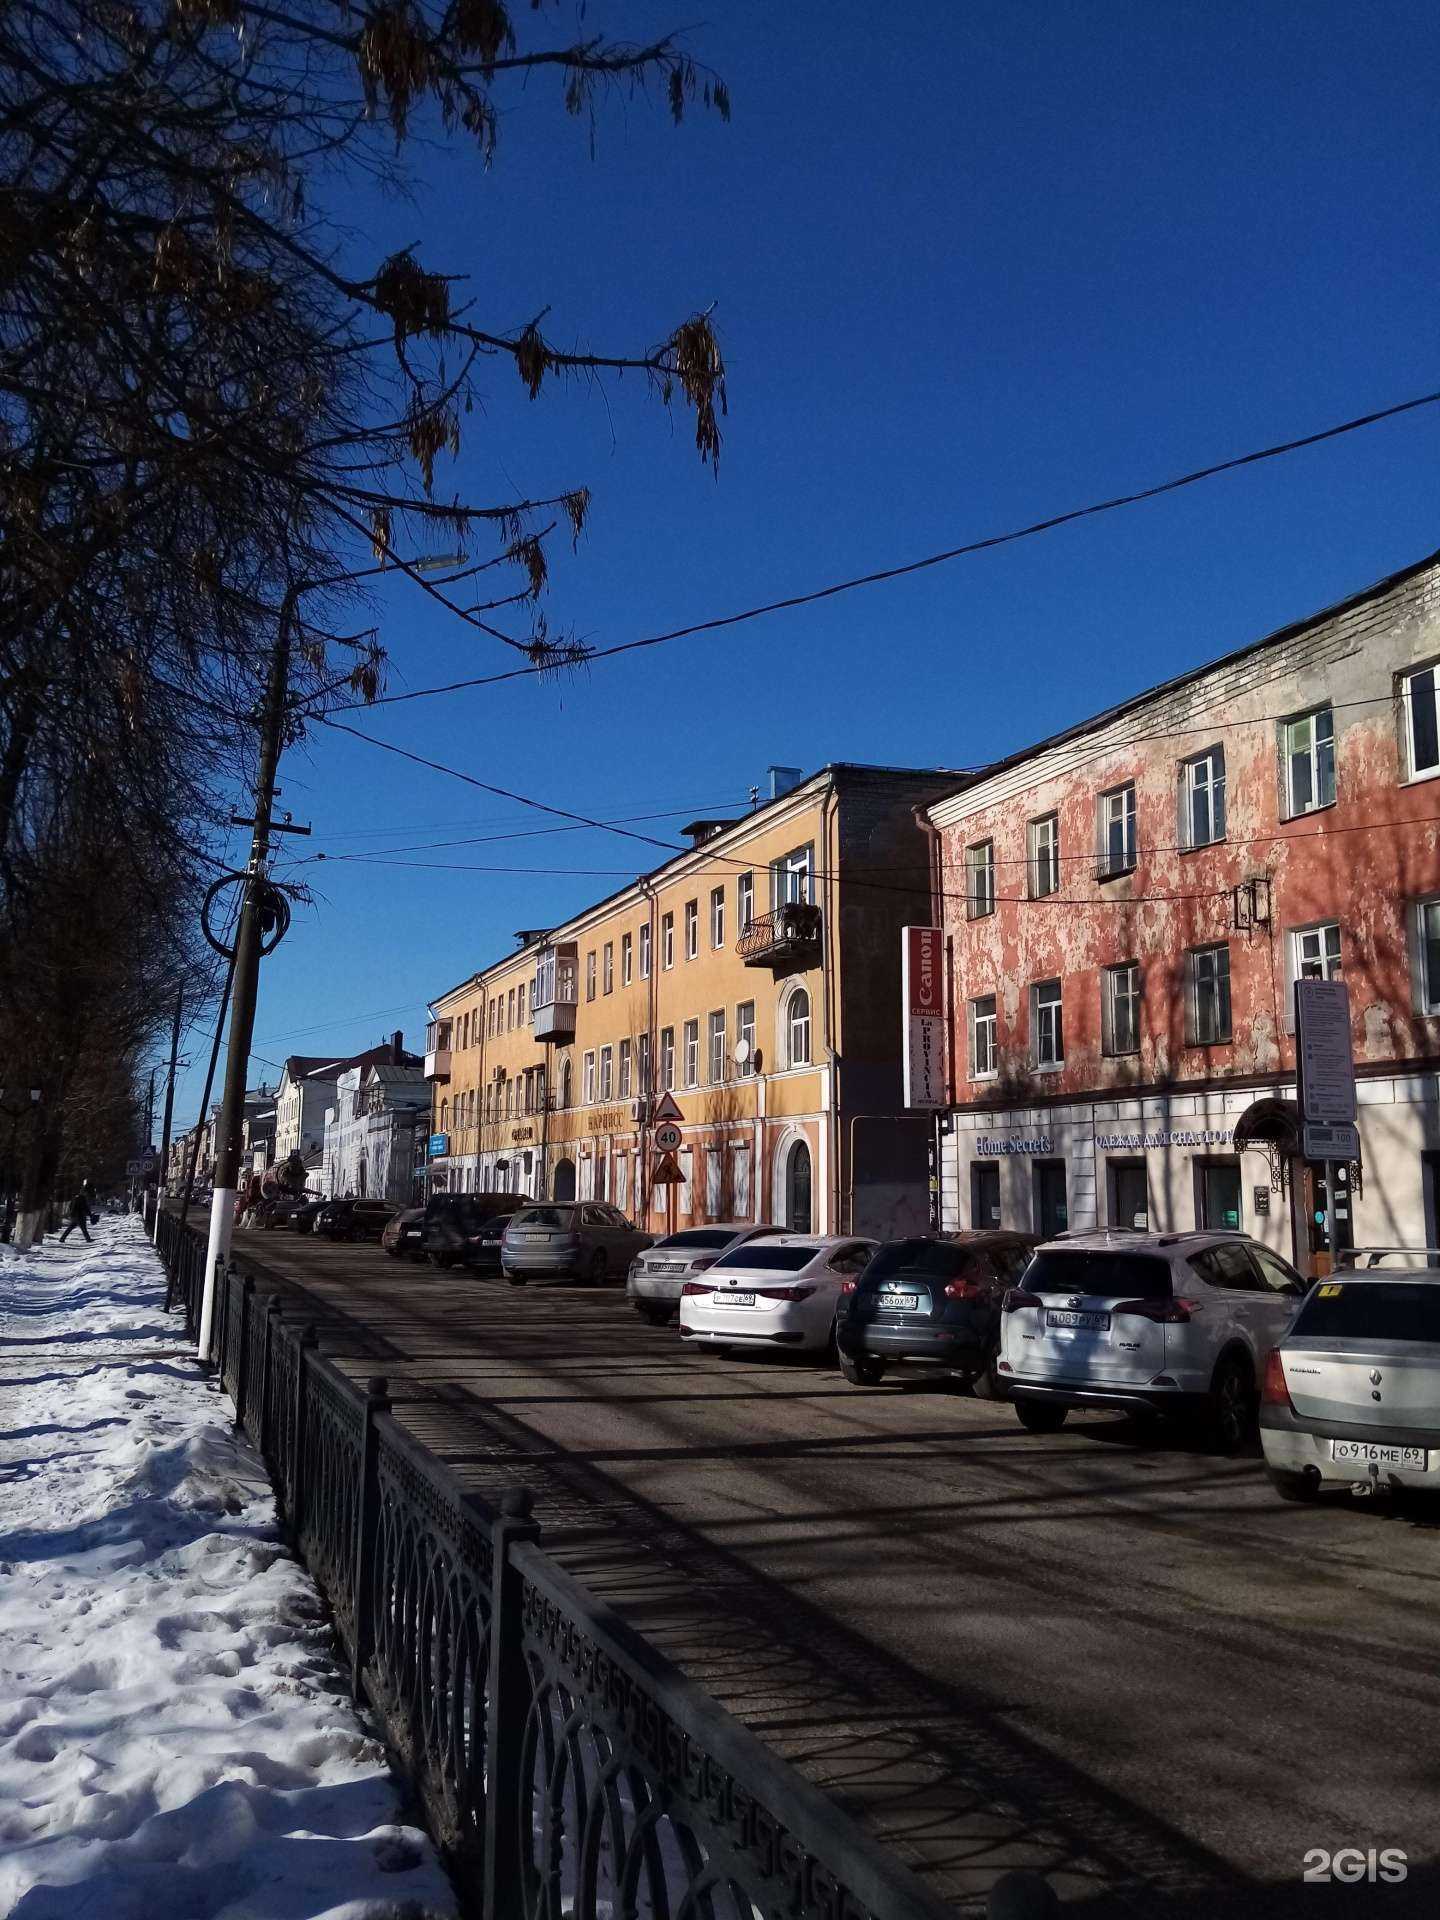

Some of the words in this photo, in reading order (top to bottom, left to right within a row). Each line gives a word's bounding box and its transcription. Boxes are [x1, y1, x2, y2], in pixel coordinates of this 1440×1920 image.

[920, 931, 933, 1006] Canon
[912, 1008, 941, 1016] СЕРВИС
[588, 1111, 624, 1130] НАРЦИСС
[660, 1132, 676, 1143] 40
[976, 1136, 1007, 1154] Home
[1095, 1133, 1140, 1148] ОДЕЖДА
[1144, 1131, 1166, 1147] ДЛЯ
[1339, 1444, 1399, 1462] О916МЕ
[1404, 1447, 1419, 1460] 69
